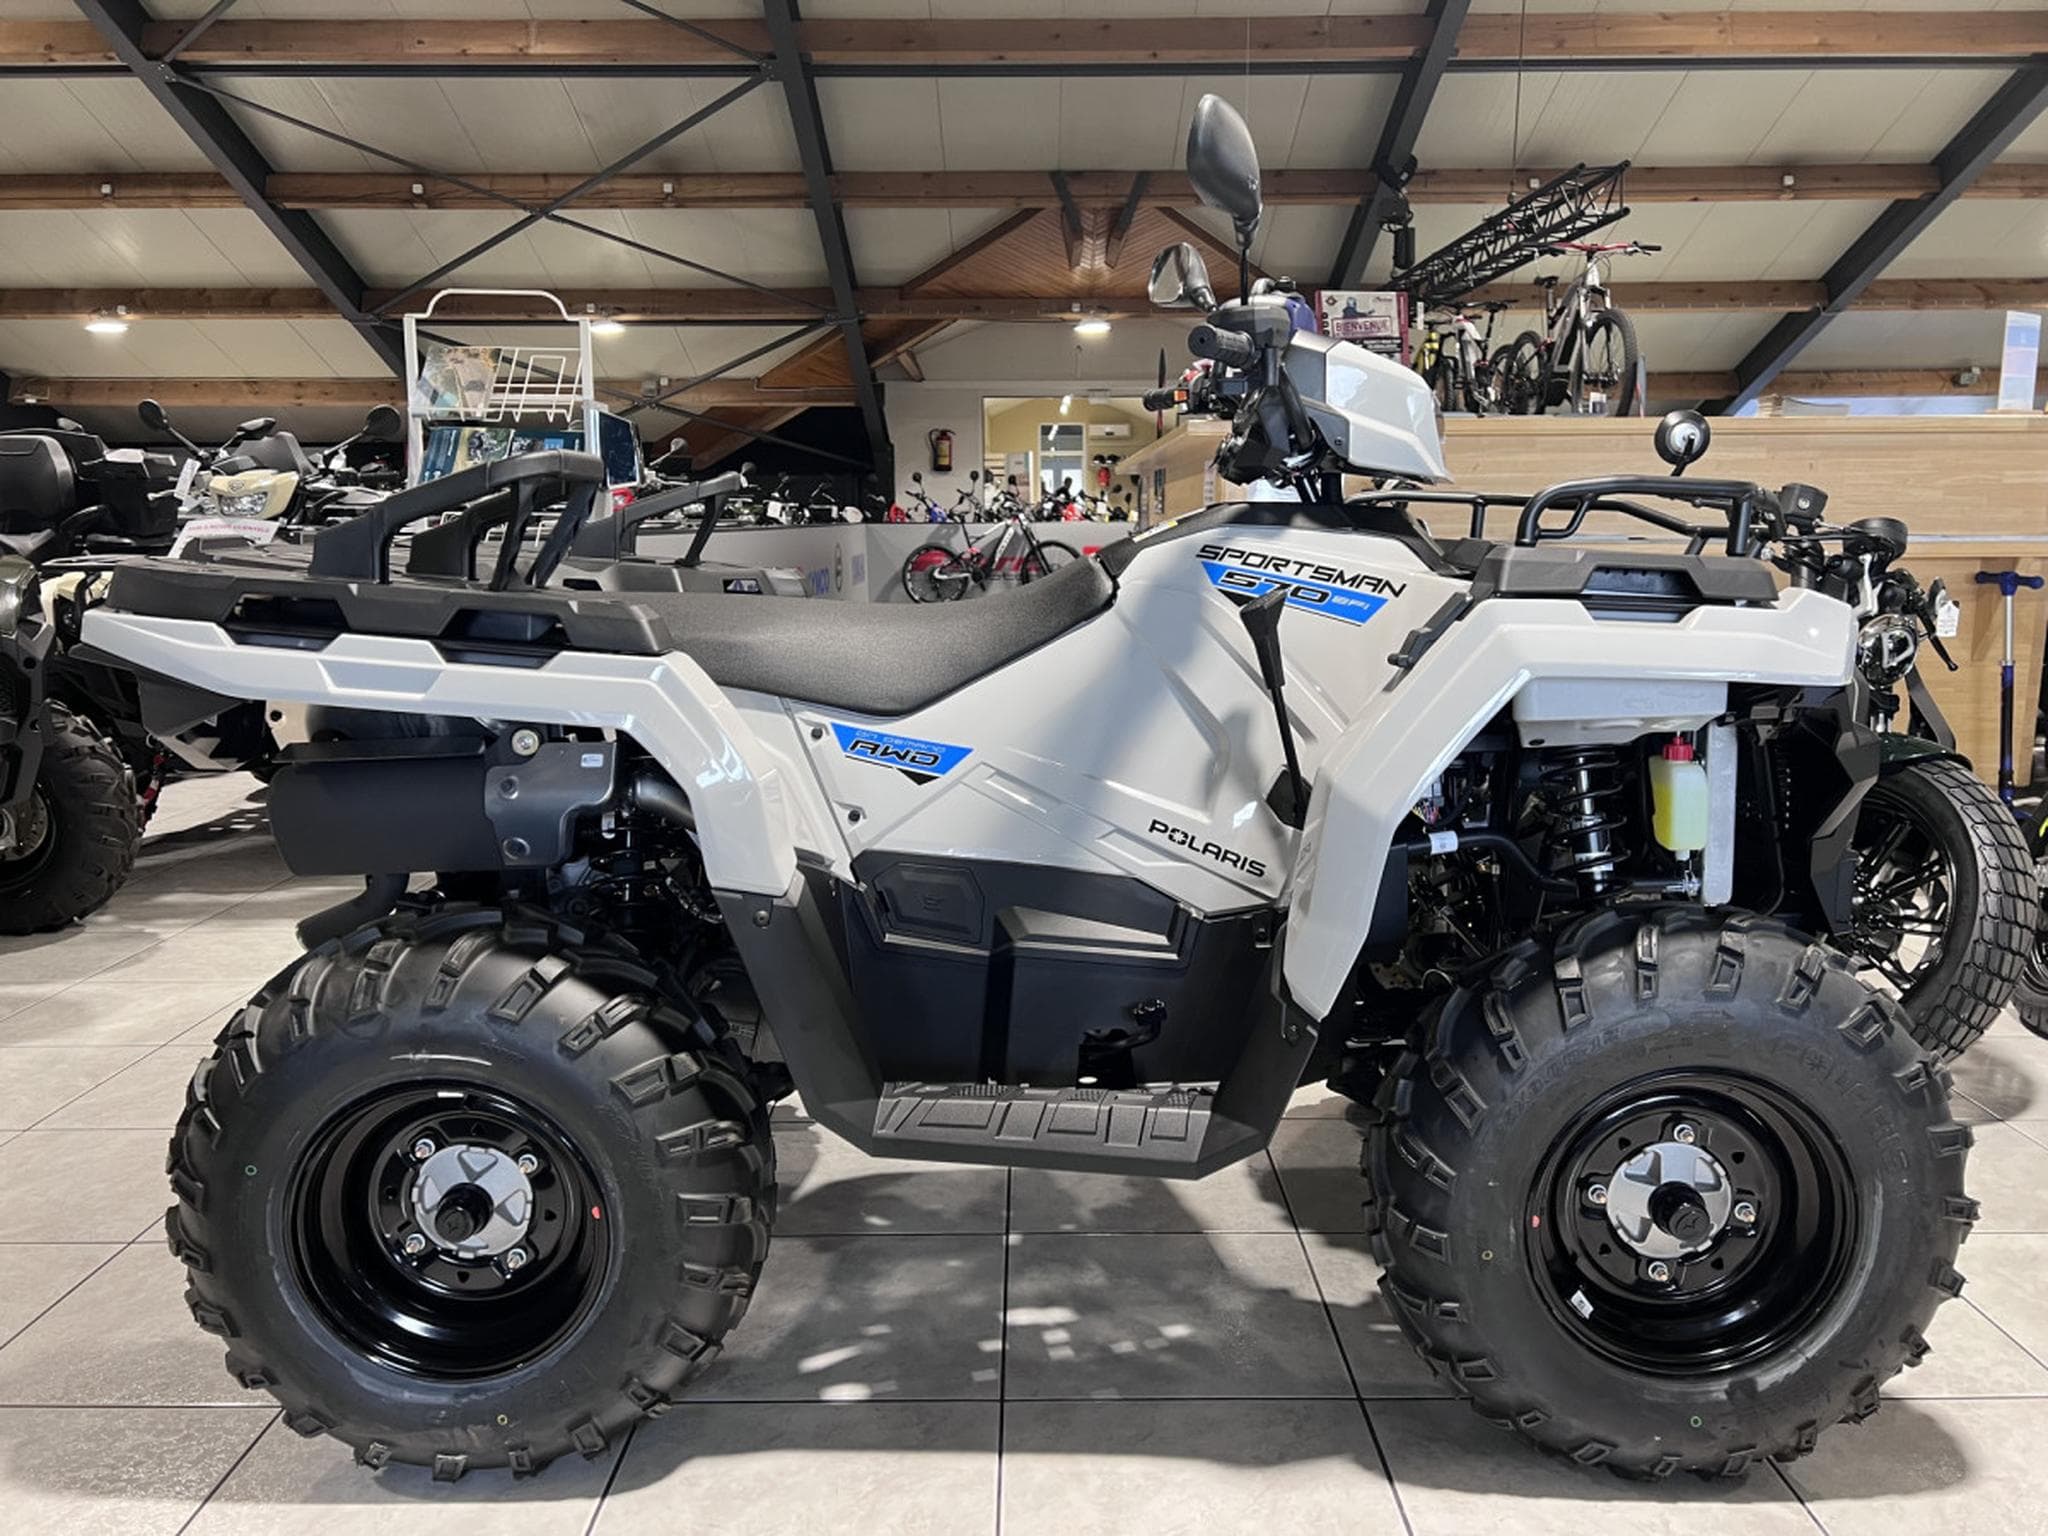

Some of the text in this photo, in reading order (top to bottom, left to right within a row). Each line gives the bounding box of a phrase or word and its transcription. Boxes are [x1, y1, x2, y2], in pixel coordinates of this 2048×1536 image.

[1196, 544, 1407, 598] SPORTSMAN
[1219, 570, 1332, 604] 570
[849, 738, 941, 767] AWD
[855, 730, 946, 753] ON DEMAND
[1148, 819, 1267, 878] POLARIS
